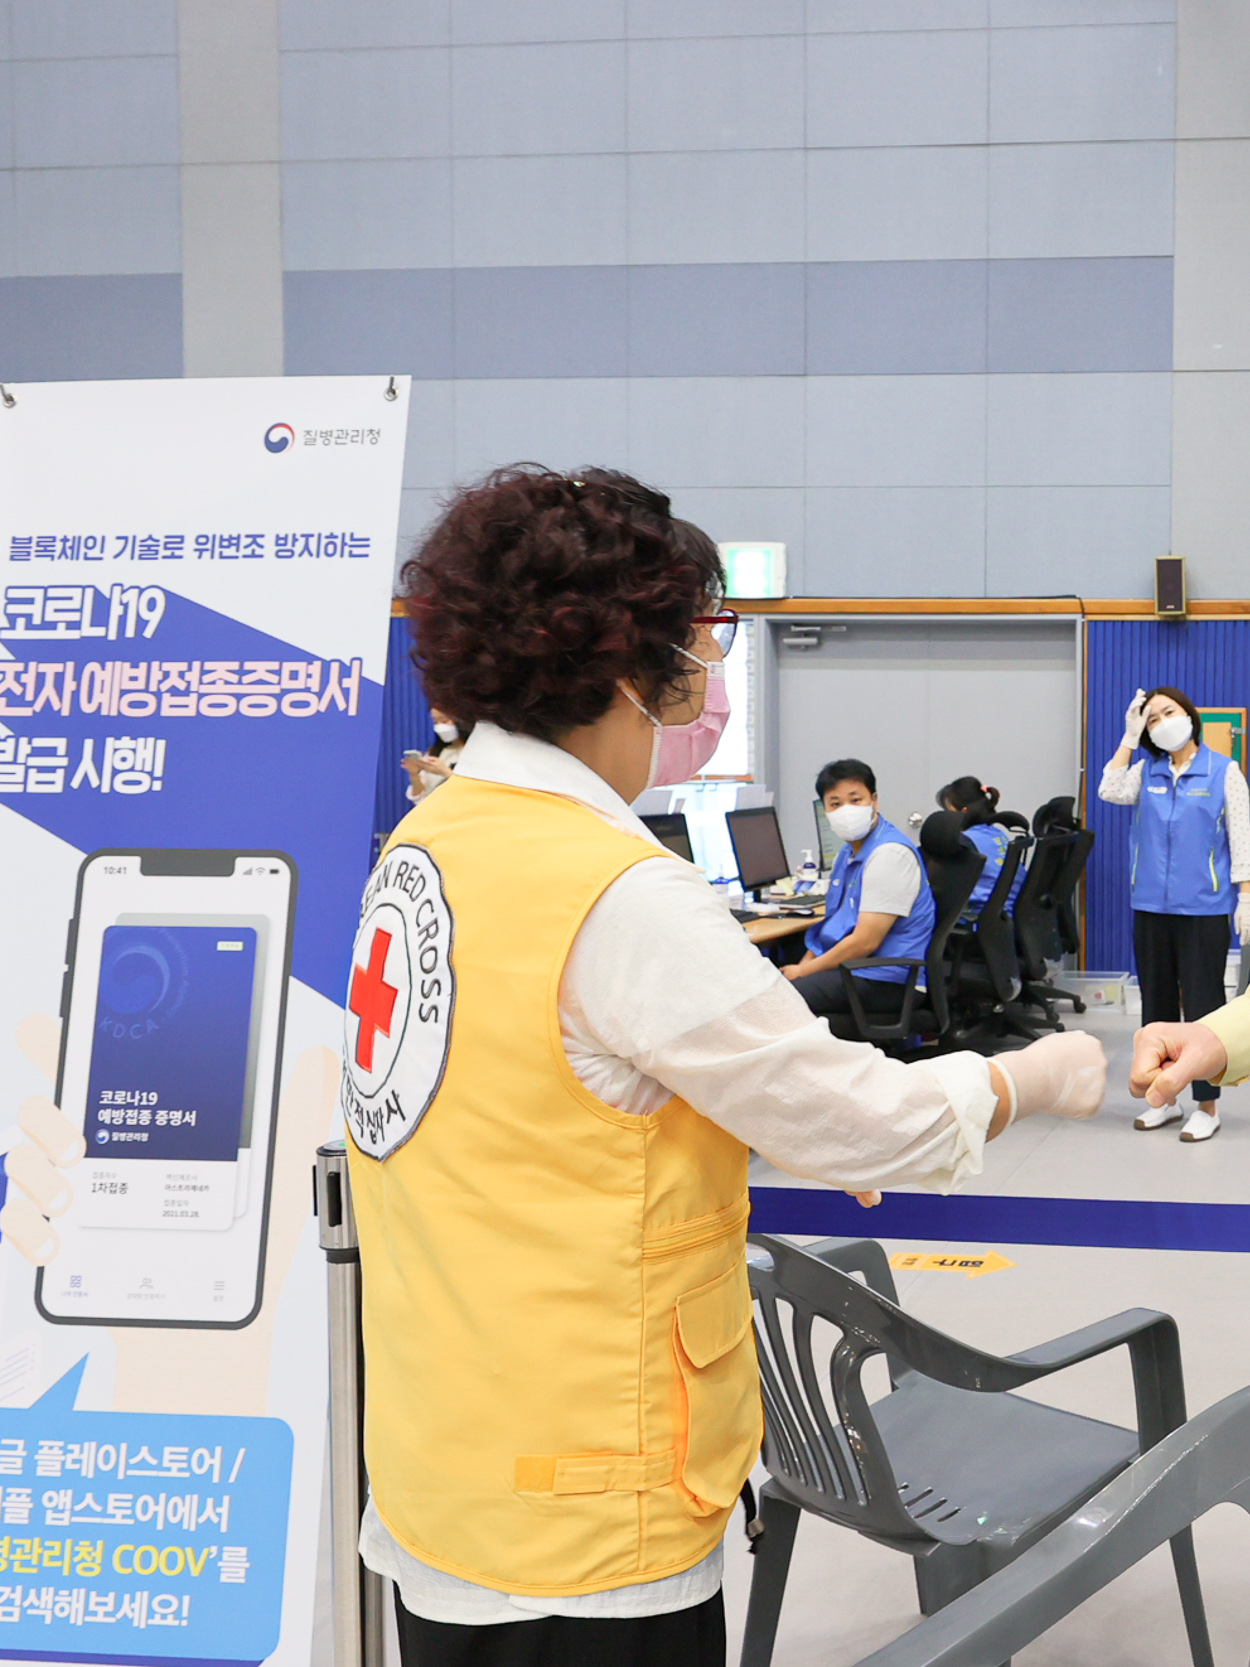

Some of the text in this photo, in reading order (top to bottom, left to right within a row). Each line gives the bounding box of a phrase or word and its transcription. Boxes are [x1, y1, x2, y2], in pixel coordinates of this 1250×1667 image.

[303, 427, 381, 446] 질병관리청
[9, 532, 371, 562] 블록체인 기술로 위변조 방지하는
[0, 583, 166, 640] 코로나19
[0, 658, 361, 717] 전자 예방접종증명서
[0, 736, 166, 795] 발급 시행!
[103, 866, 127, 875] 10:41
[393, 860, 426, 902] RED
[414, 898, 442, 1024] CROSS
[97, 1109, 198, 1127] 예방접종 증명서
[99, 1090, 158, 1107] 코로나19
[91, 1182, 129, 1195] 1차접종
[34, 1440, 222, 1483] 플레이스토어
[0, 1486, 231, 1533] 플 앱스토어에서
[0, 1536, 104, 1578] 관리청
[0, 1585, 191, 1630] 검색해보세요!
